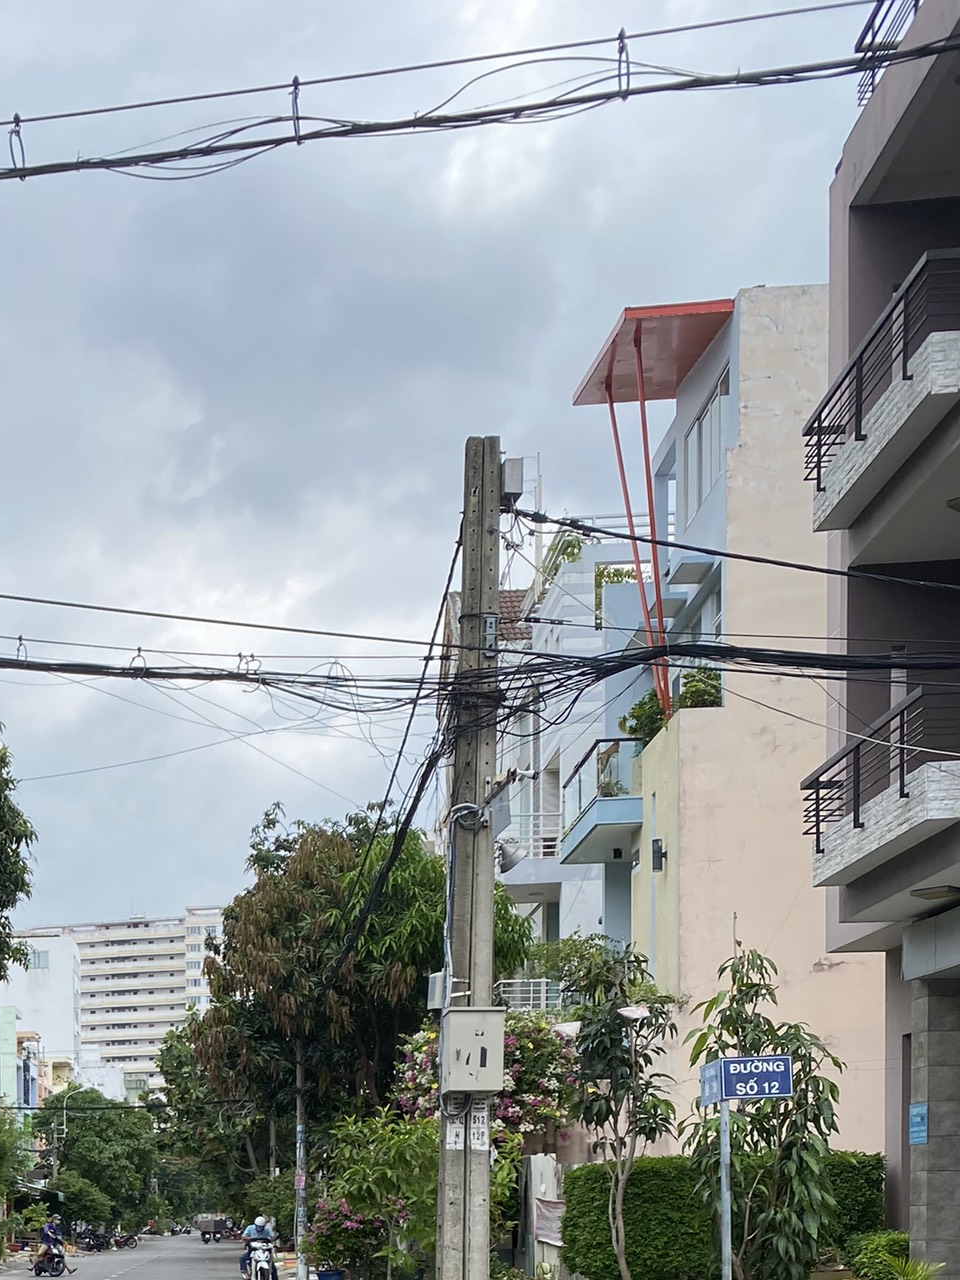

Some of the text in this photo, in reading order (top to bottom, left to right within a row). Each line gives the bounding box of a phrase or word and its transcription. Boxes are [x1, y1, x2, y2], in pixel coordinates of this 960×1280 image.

[730, 1060, 785, 1074] ĐƯỜNG
[736, 1077, 758, 1095] SỐ
[763, 1081, 780, 1094] 12
